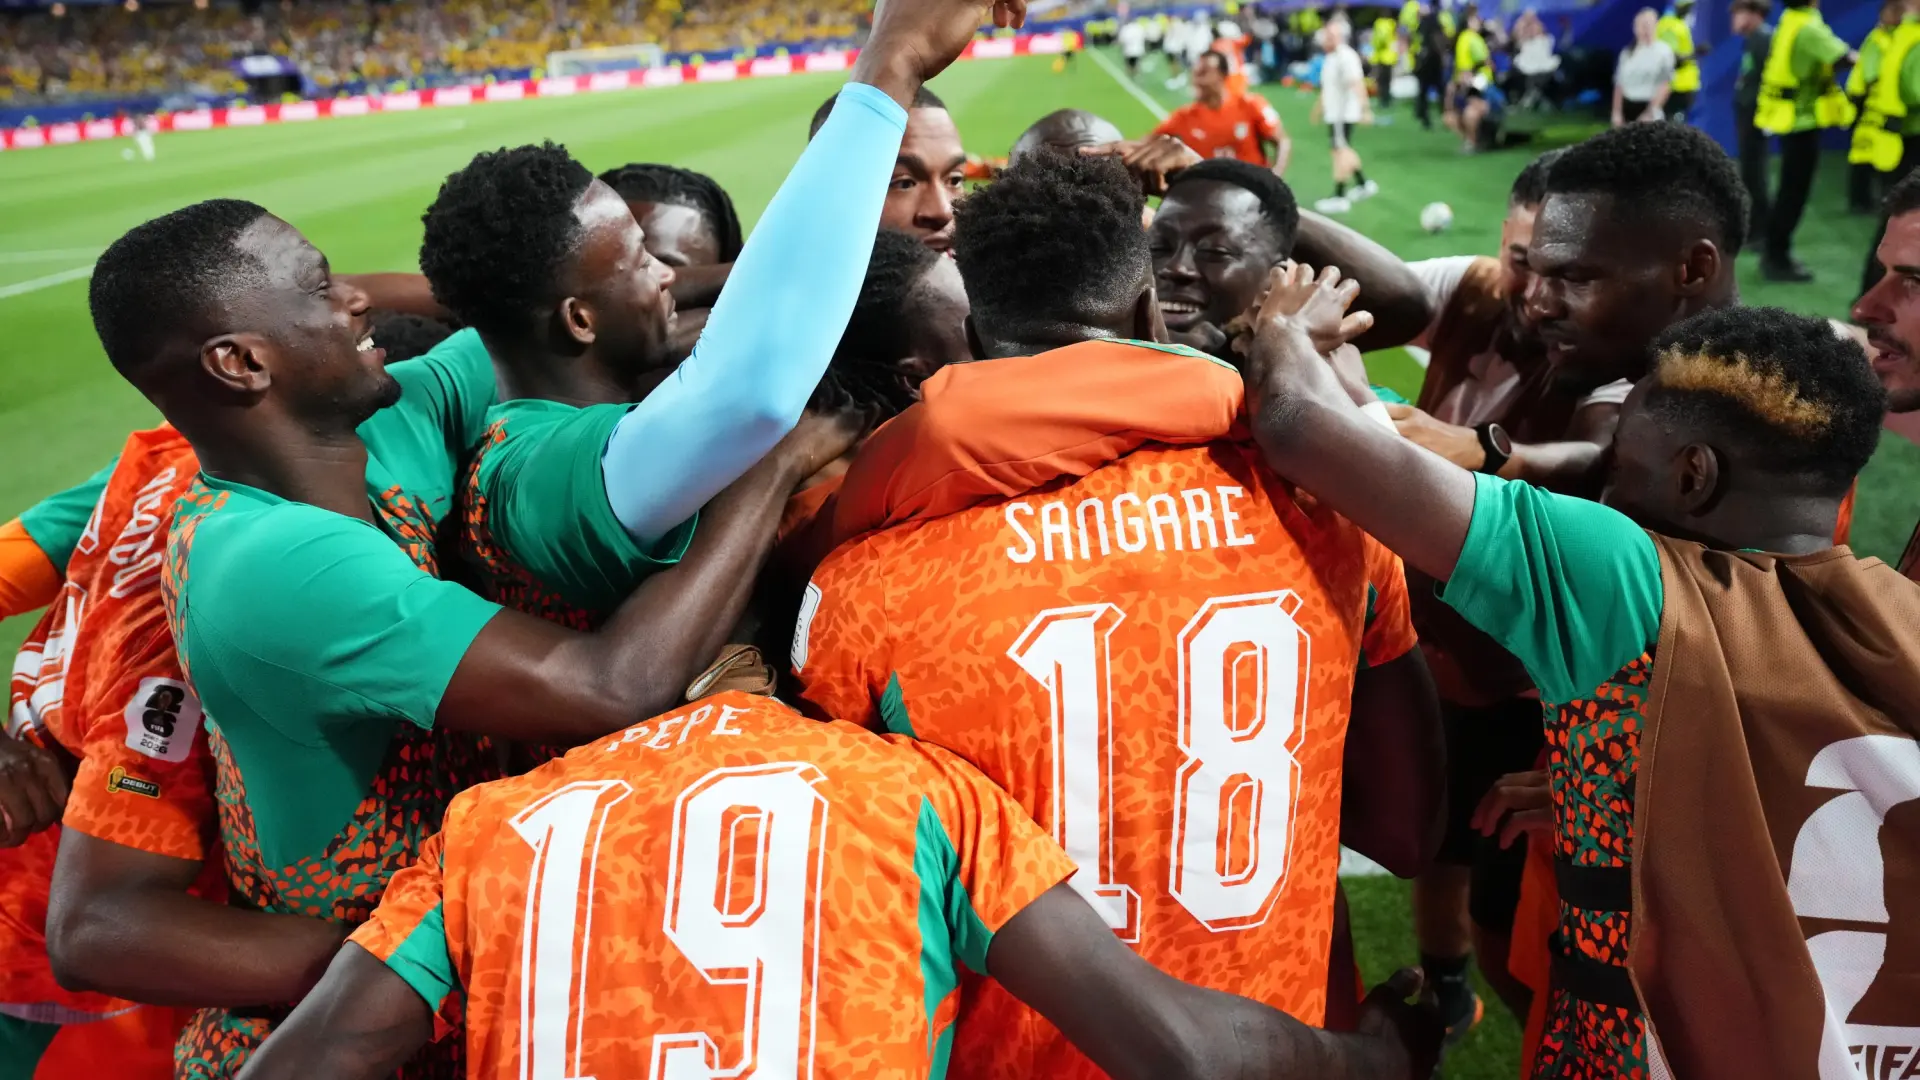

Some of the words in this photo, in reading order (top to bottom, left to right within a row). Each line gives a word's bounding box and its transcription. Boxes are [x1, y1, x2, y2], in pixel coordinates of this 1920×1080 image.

[1005, 485, 1255, 563] SANGARE
[140, 739, 168, 755] 2026
[150, 724, 165, 734] FIFA
[606, 704, 751, 752] PEPE
[121, 778, 157, 793] DEBUT
[1006, 589, 1310, 944] 18
[508, 761, 829, 1080] 19
